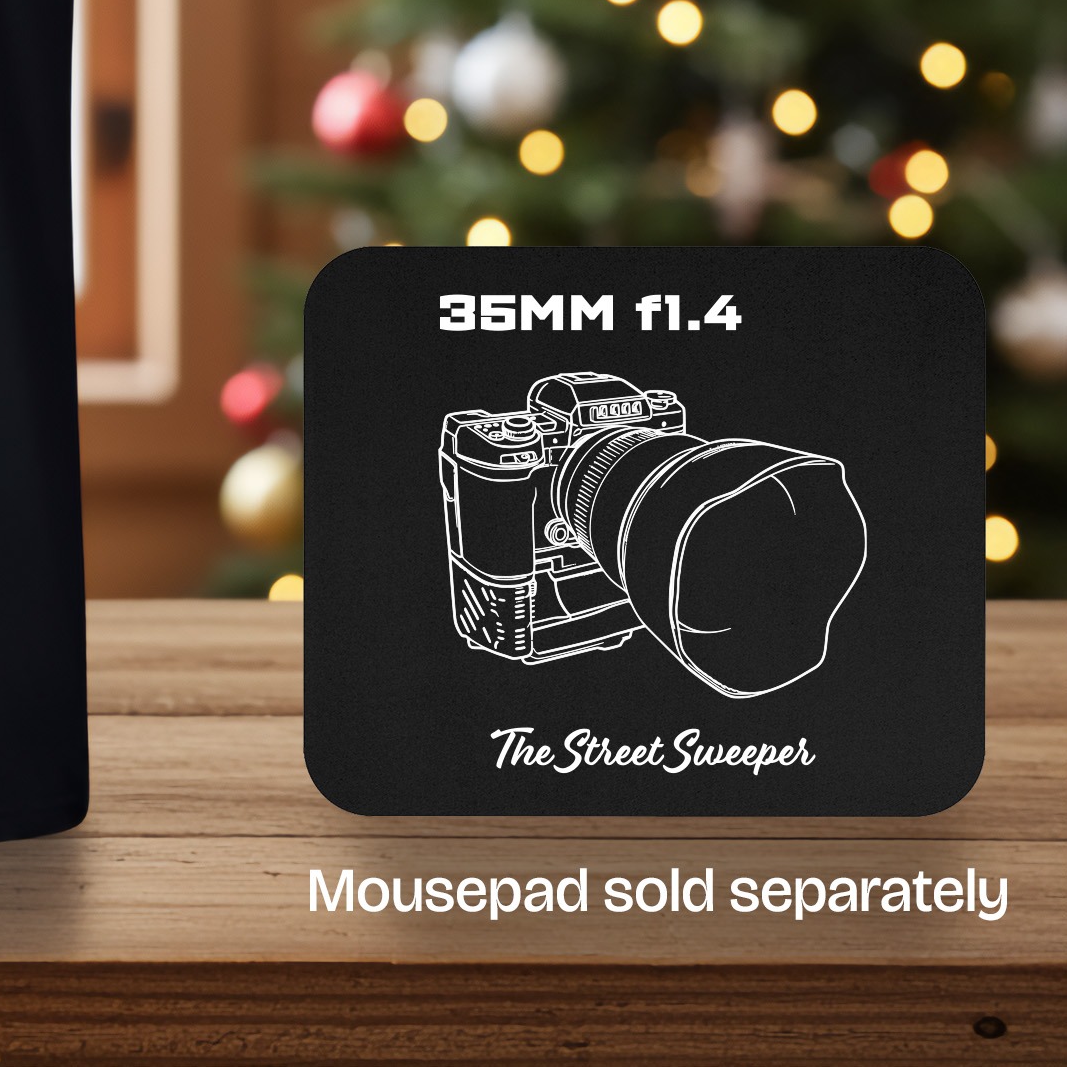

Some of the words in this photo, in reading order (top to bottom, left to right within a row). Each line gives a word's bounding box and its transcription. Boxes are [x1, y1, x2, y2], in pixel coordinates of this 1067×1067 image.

[439, 294, 614, 332] 35MM
[635, 294, 743, 331] f1.4
[490, 726, 556, 769] The
[552, 728, 665, 774] Street
[662, 728, 817, 776] Sweeper
